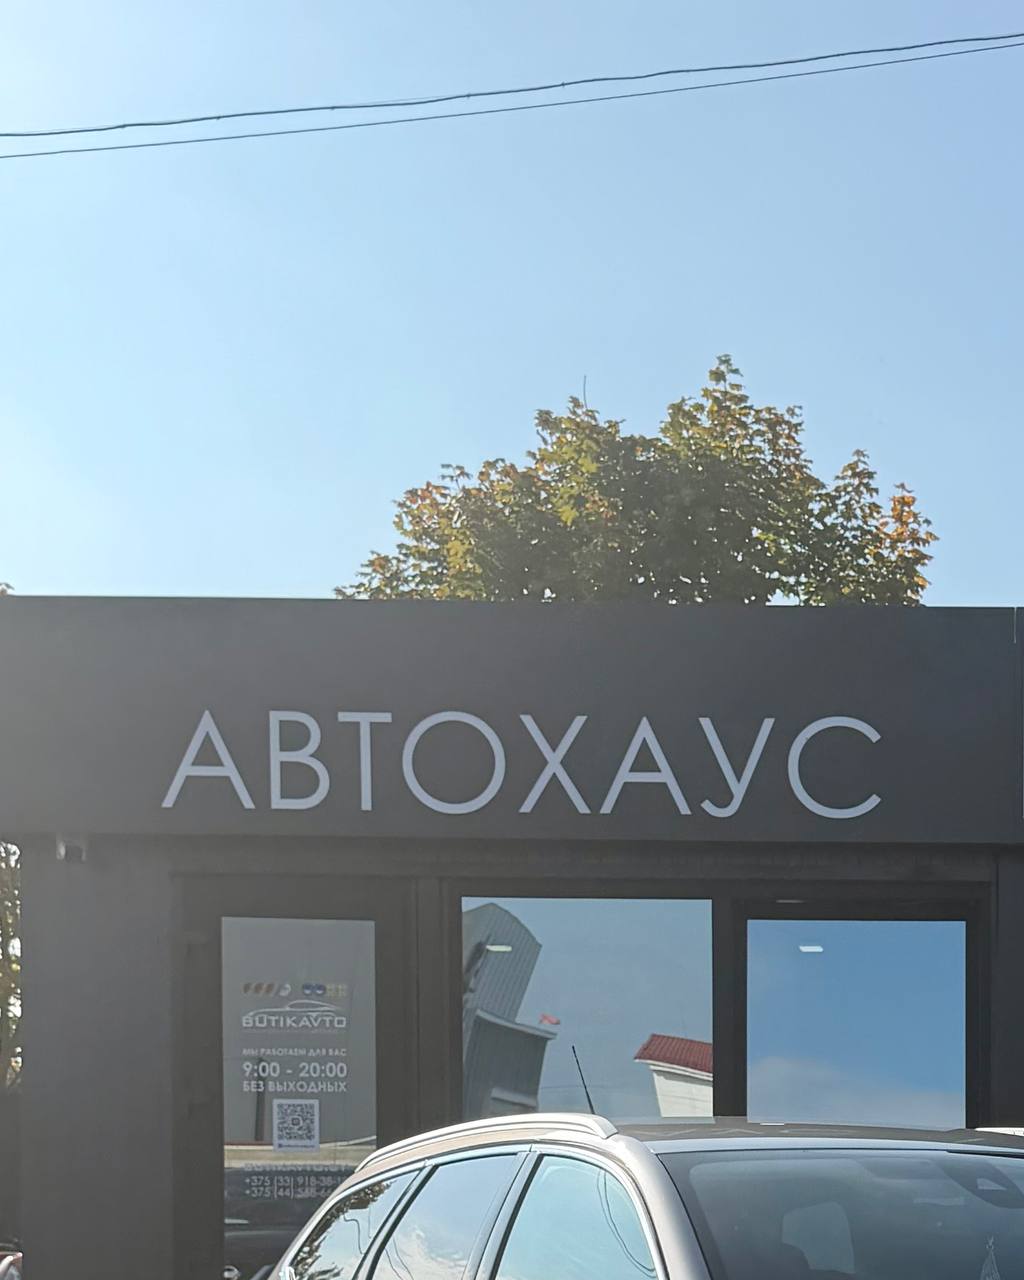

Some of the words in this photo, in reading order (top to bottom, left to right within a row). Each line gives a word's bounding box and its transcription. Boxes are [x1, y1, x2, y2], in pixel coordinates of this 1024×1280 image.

[161, 708, 883, 819] АВТОХАУС
[242, 1015, 347, 1028] BUTIKAVTO
[242, 1062, 280, 1078] 9:00
[299, 1062, 348, 1078] 20:00
[242, 1081, 265, 1093] БЕЗ
[268, 1081, 348, 1093] ВЫХОДНЫХ
[244, 1175, 270, 1186] +375
[296, 1175, 346, 1187] 918-38-1
[244, 1187, 270, 1198] +375
